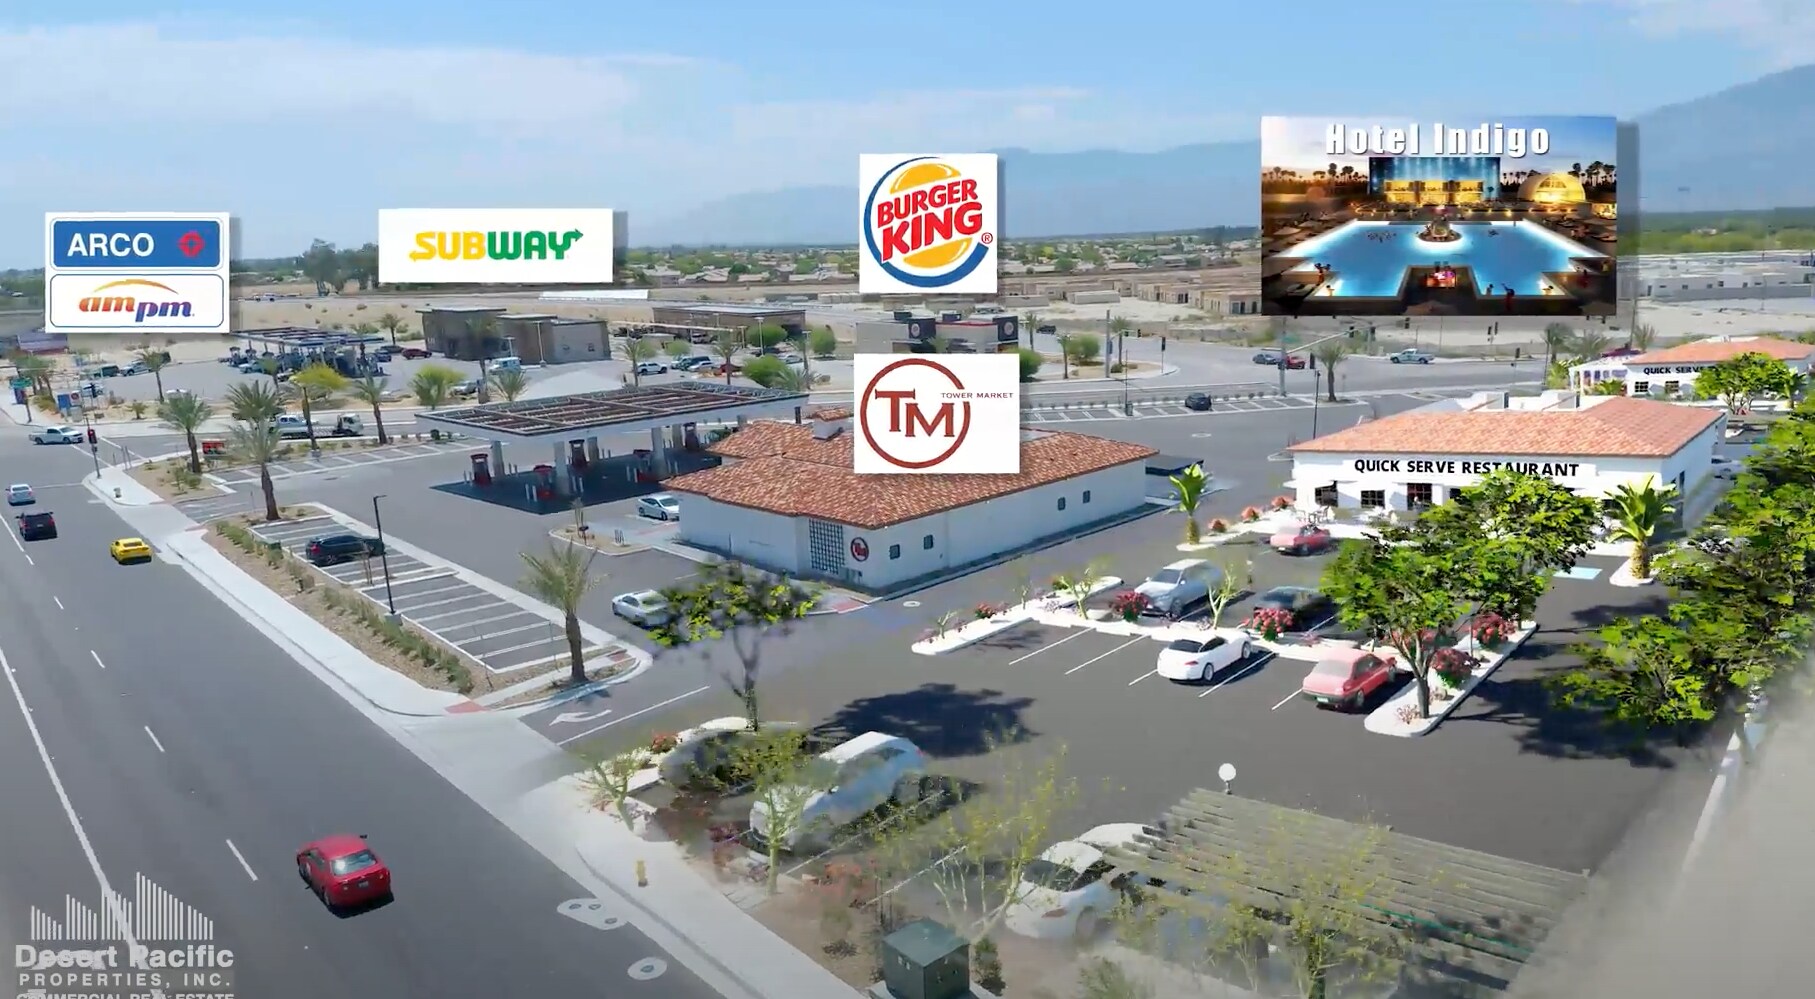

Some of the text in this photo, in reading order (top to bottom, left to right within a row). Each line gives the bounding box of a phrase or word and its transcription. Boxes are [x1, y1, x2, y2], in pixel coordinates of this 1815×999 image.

[1643, 366, 1671, 375] QUICK
[1354, 459, 1579, 477] QUICK SERVE RESTAURANT
